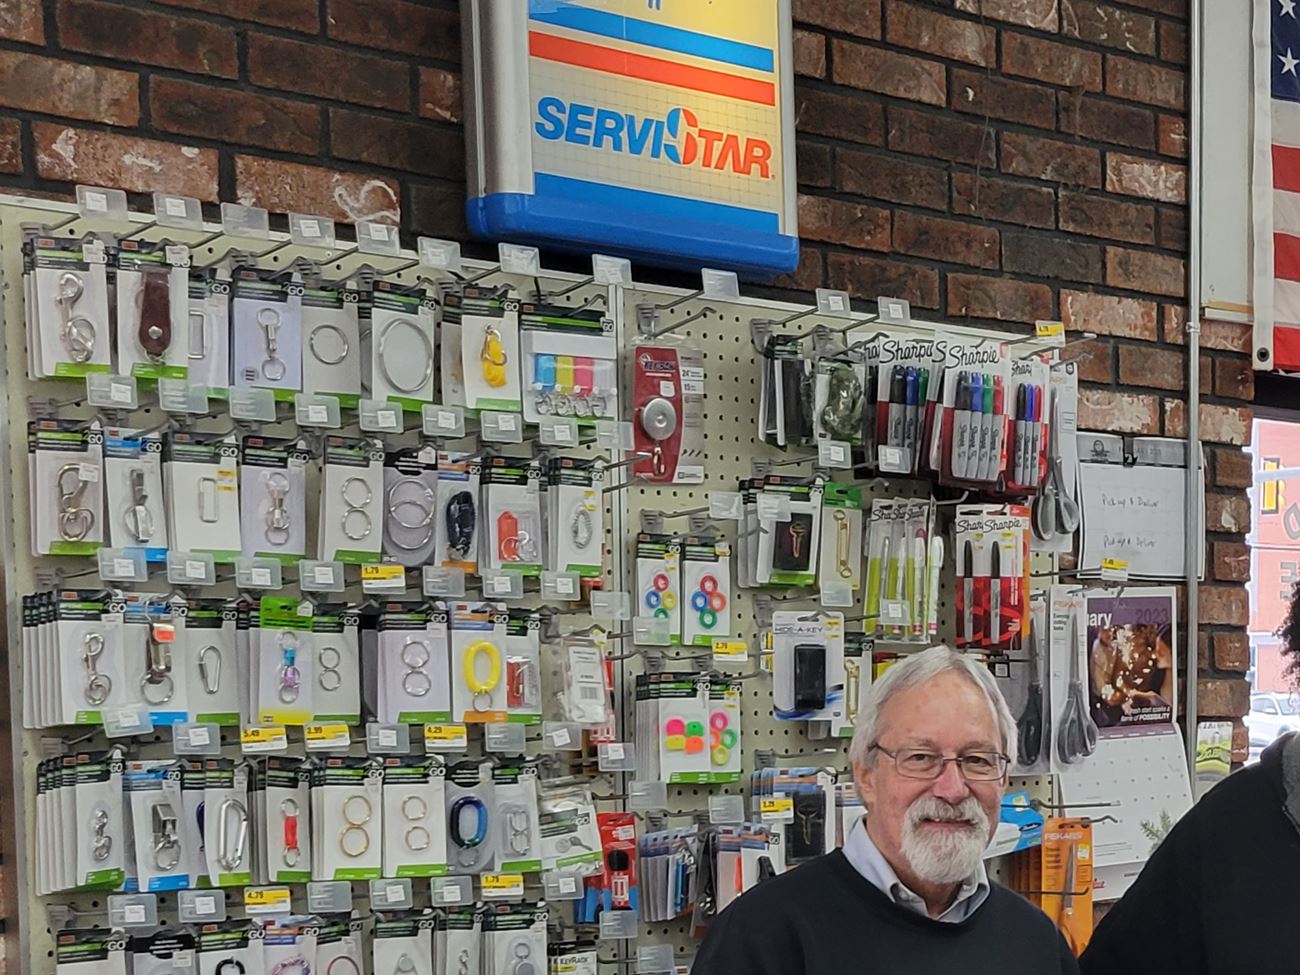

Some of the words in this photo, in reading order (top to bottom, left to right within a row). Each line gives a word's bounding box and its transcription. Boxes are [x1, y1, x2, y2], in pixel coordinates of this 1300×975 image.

[535, 96, 772, 179] SERVISTAR
[945, 346, 999, 368] Sharpie
[983, 518, 1022, 533] Sharpie
[1135, 608, 1168, 624] 2023
